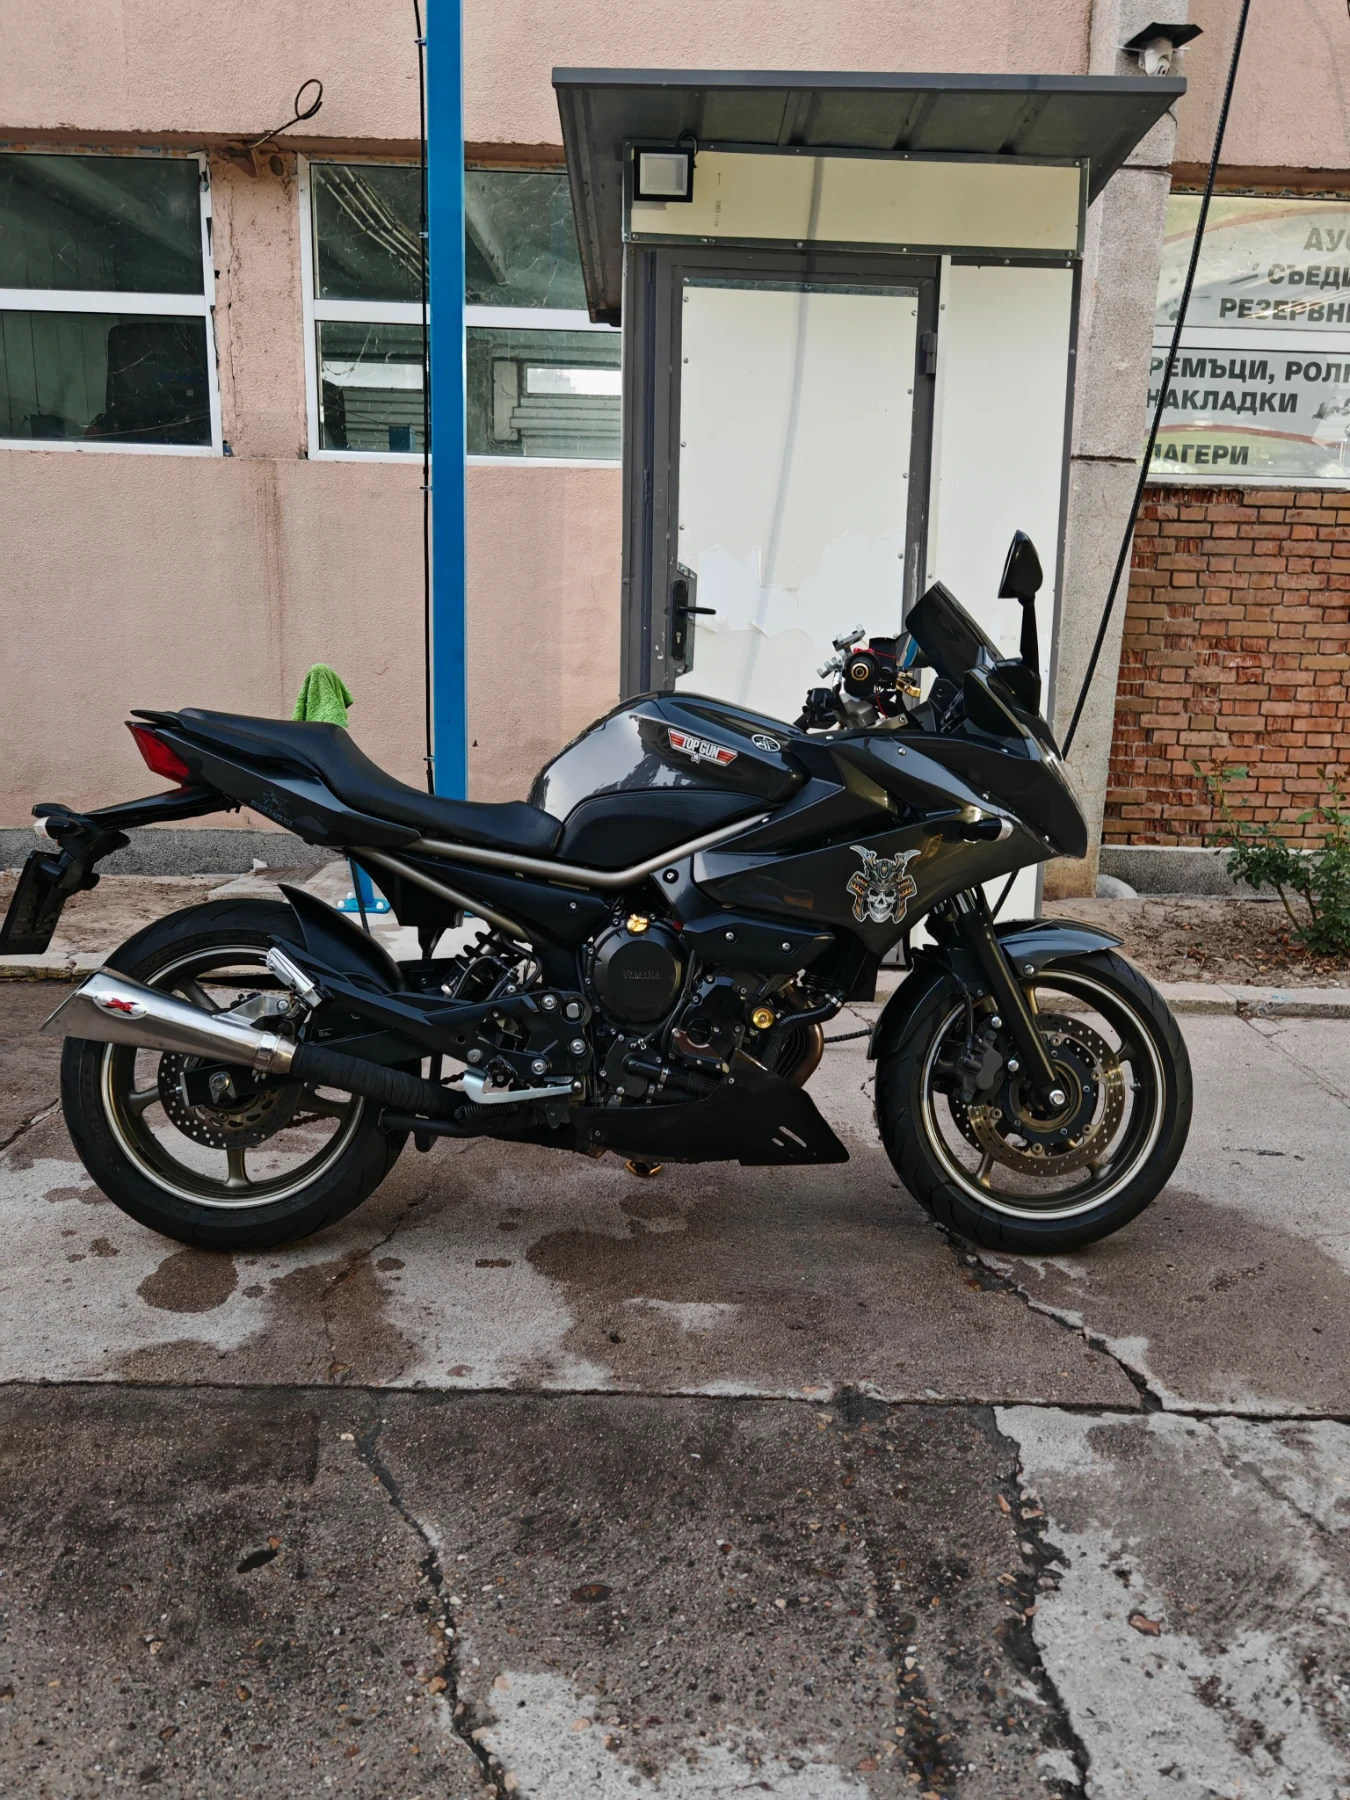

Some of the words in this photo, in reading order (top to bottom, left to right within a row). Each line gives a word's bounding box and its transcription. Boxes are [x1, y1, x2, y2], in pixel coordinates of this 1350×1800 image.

[1303, 228, 1350, 253] АУ
[1218, 298, 1350, 324] РЕЗЕРВН
[1146, 388, 1298, 416] НАКЛАДКИ
[682, 736, 700, 752] TOP
[700, 741, 720, 759] GUN
[622, 968, 662, 981] YAMAHA
